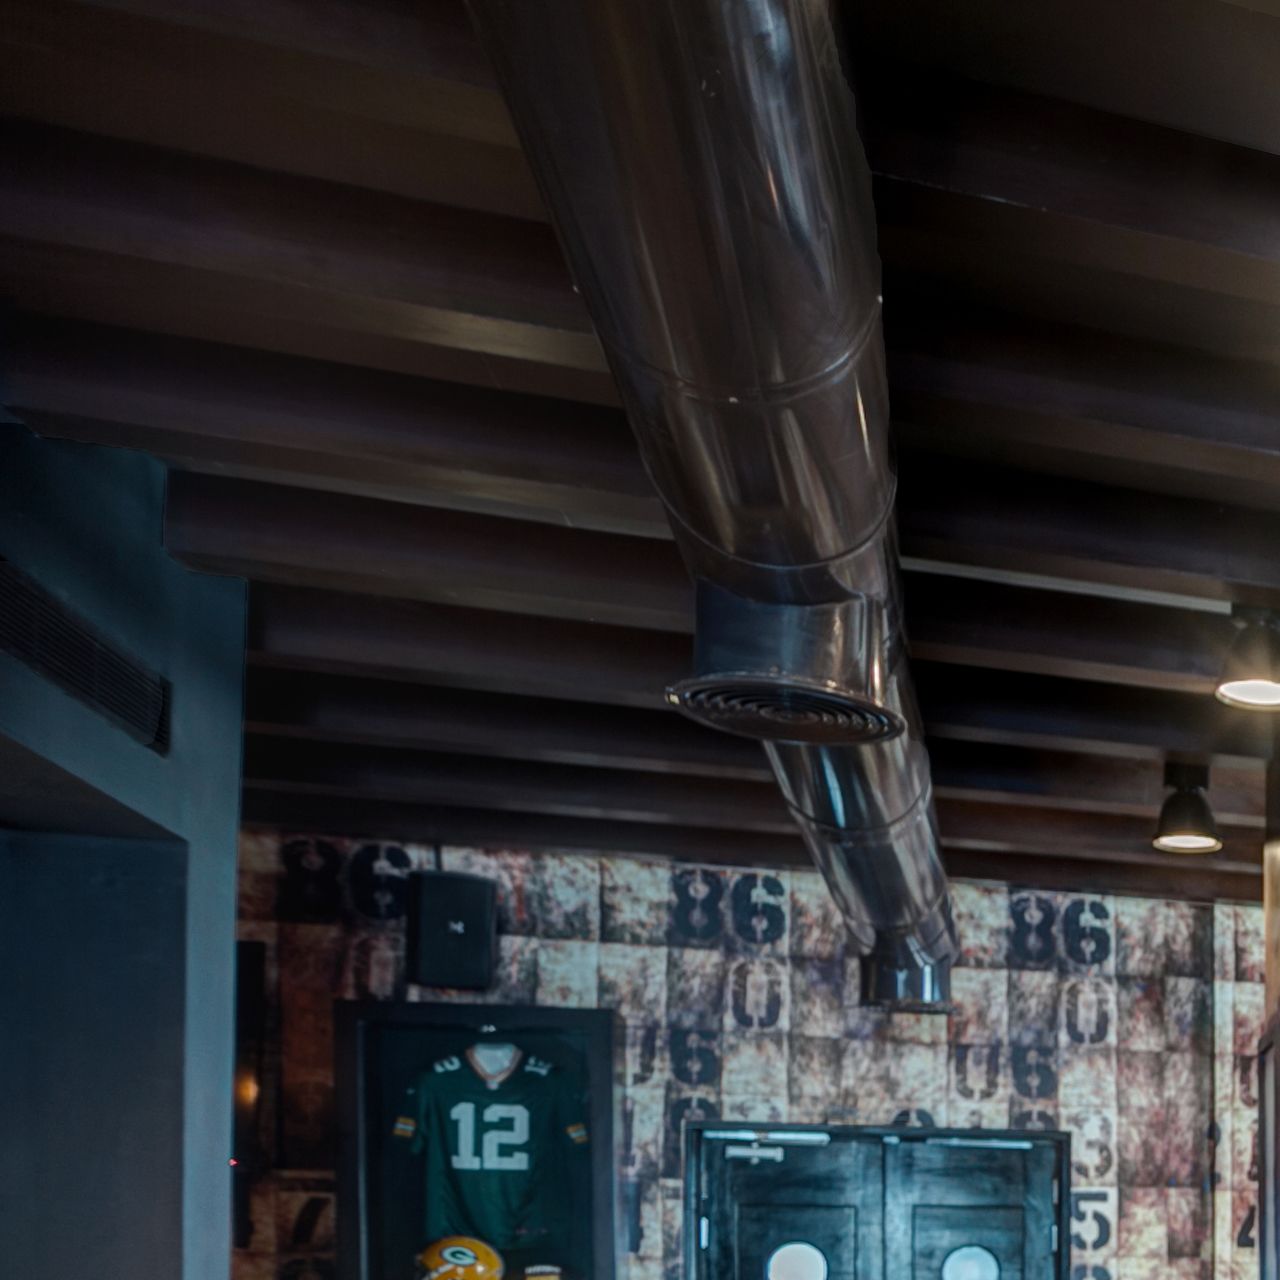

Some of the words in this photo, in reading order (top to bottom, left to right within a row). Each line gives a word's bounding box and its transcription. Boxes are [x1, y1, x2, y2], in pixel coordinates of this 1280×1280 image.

[671, 868, 787, 945] 86
[1009, 896, 1112, 966] 86
[449, 1102, 530, 1171] 12
[1071, 1190, 1112, 1252] 5
